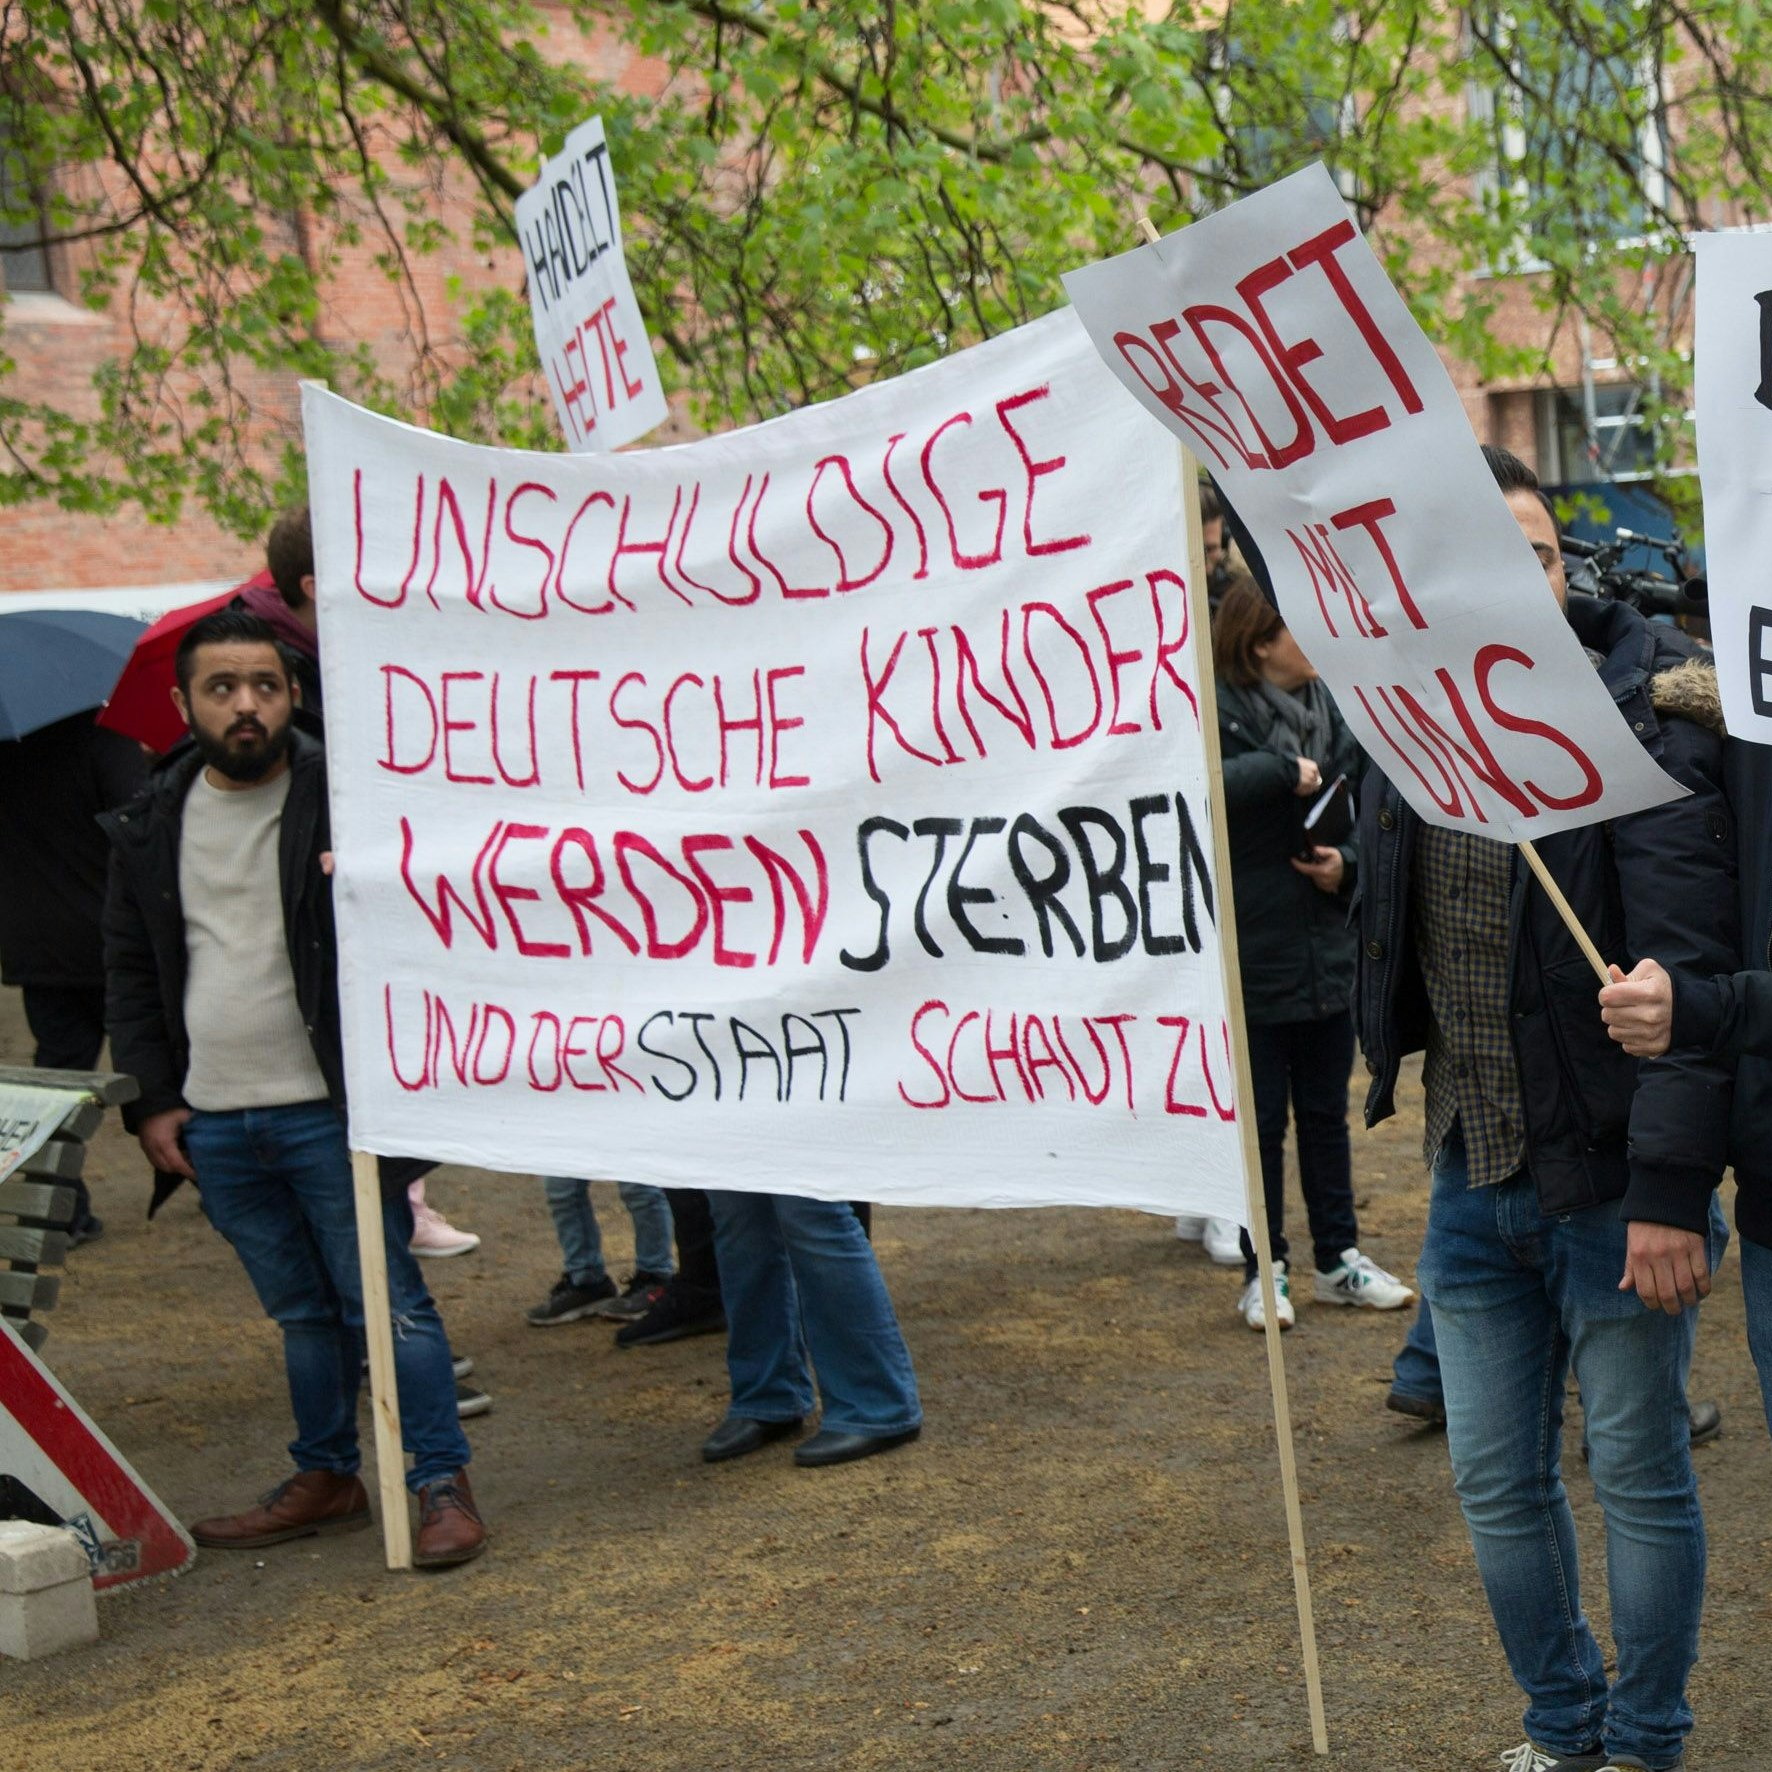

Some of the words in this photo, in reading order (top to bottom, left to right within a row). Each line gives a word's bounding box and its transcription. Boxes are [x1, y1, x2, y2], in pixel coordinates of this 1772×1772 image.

[1113, 219, 1424, 471] REDET
[354, 386, 1091, 620] UNSCHULDIGE
[1284, 498, 1430, 639] MIT
[378, 664, 811, 795] DEUTSCHE
[860, 569, 1199, 783] KINDER
[1354, 643, 1604, 823] UNS
[400, 817, 829, 969] WERDEN
[840, 790, 1217, 973] STERBEN
[385, 984, 515, 1092] UND
[528, 1011, 648, 1093] DER
[638, 1008, 862, 1103] STAAT
[897, 999, 1138, 1120] SCHAUT
[1156, 1016, 1236, 1122] ZU
